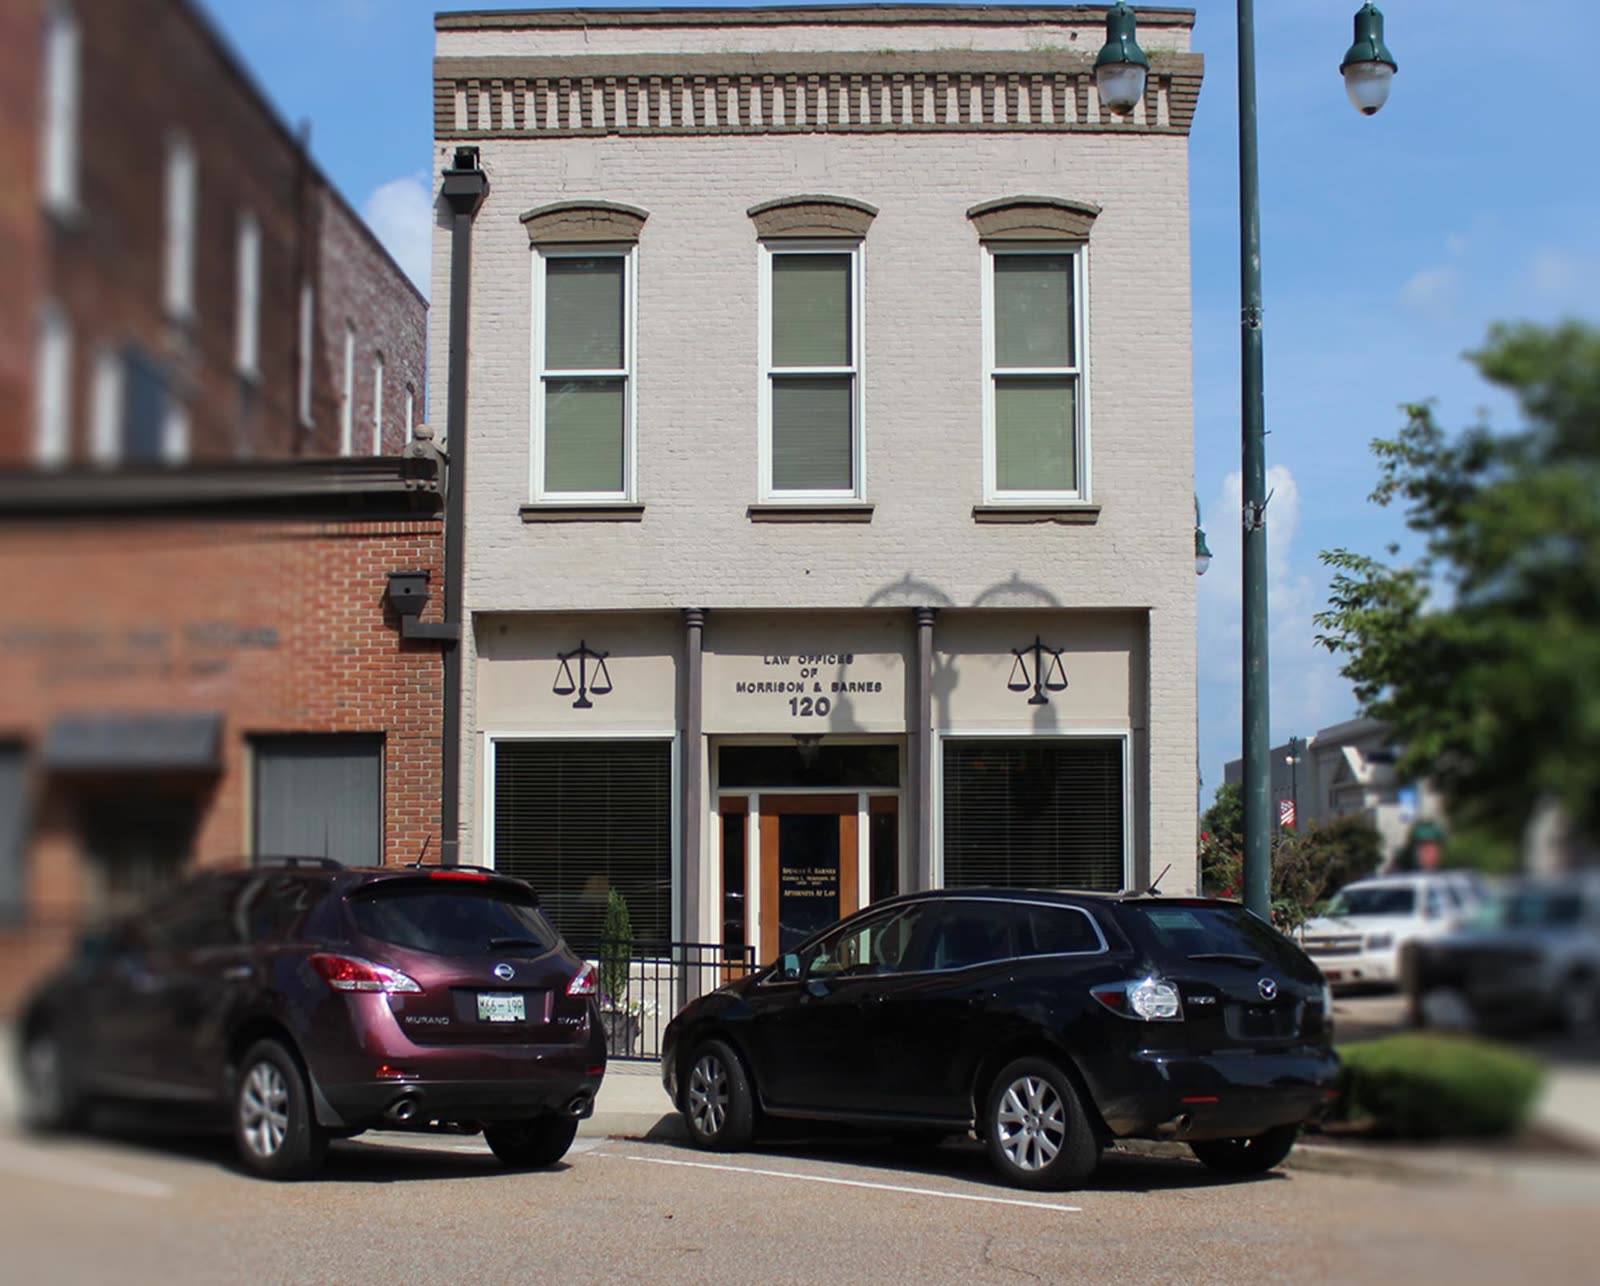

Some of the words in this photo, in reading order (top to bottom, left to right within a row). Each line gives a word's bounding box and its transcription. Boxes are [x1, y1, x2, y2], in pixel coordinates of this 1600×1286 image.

[764, 654, 790, 665] LAW
[797, 654, 854, 665] OFFICES
[800, 667, 818, 679] OF
[735, 681, 804, 693] MORRISON
[812, 681, 822, 693] &
[831, 681, 882, 693] BARNES
[788, 696, 831, 717] 120
[404, 1015, 450, 1026] MURANO
